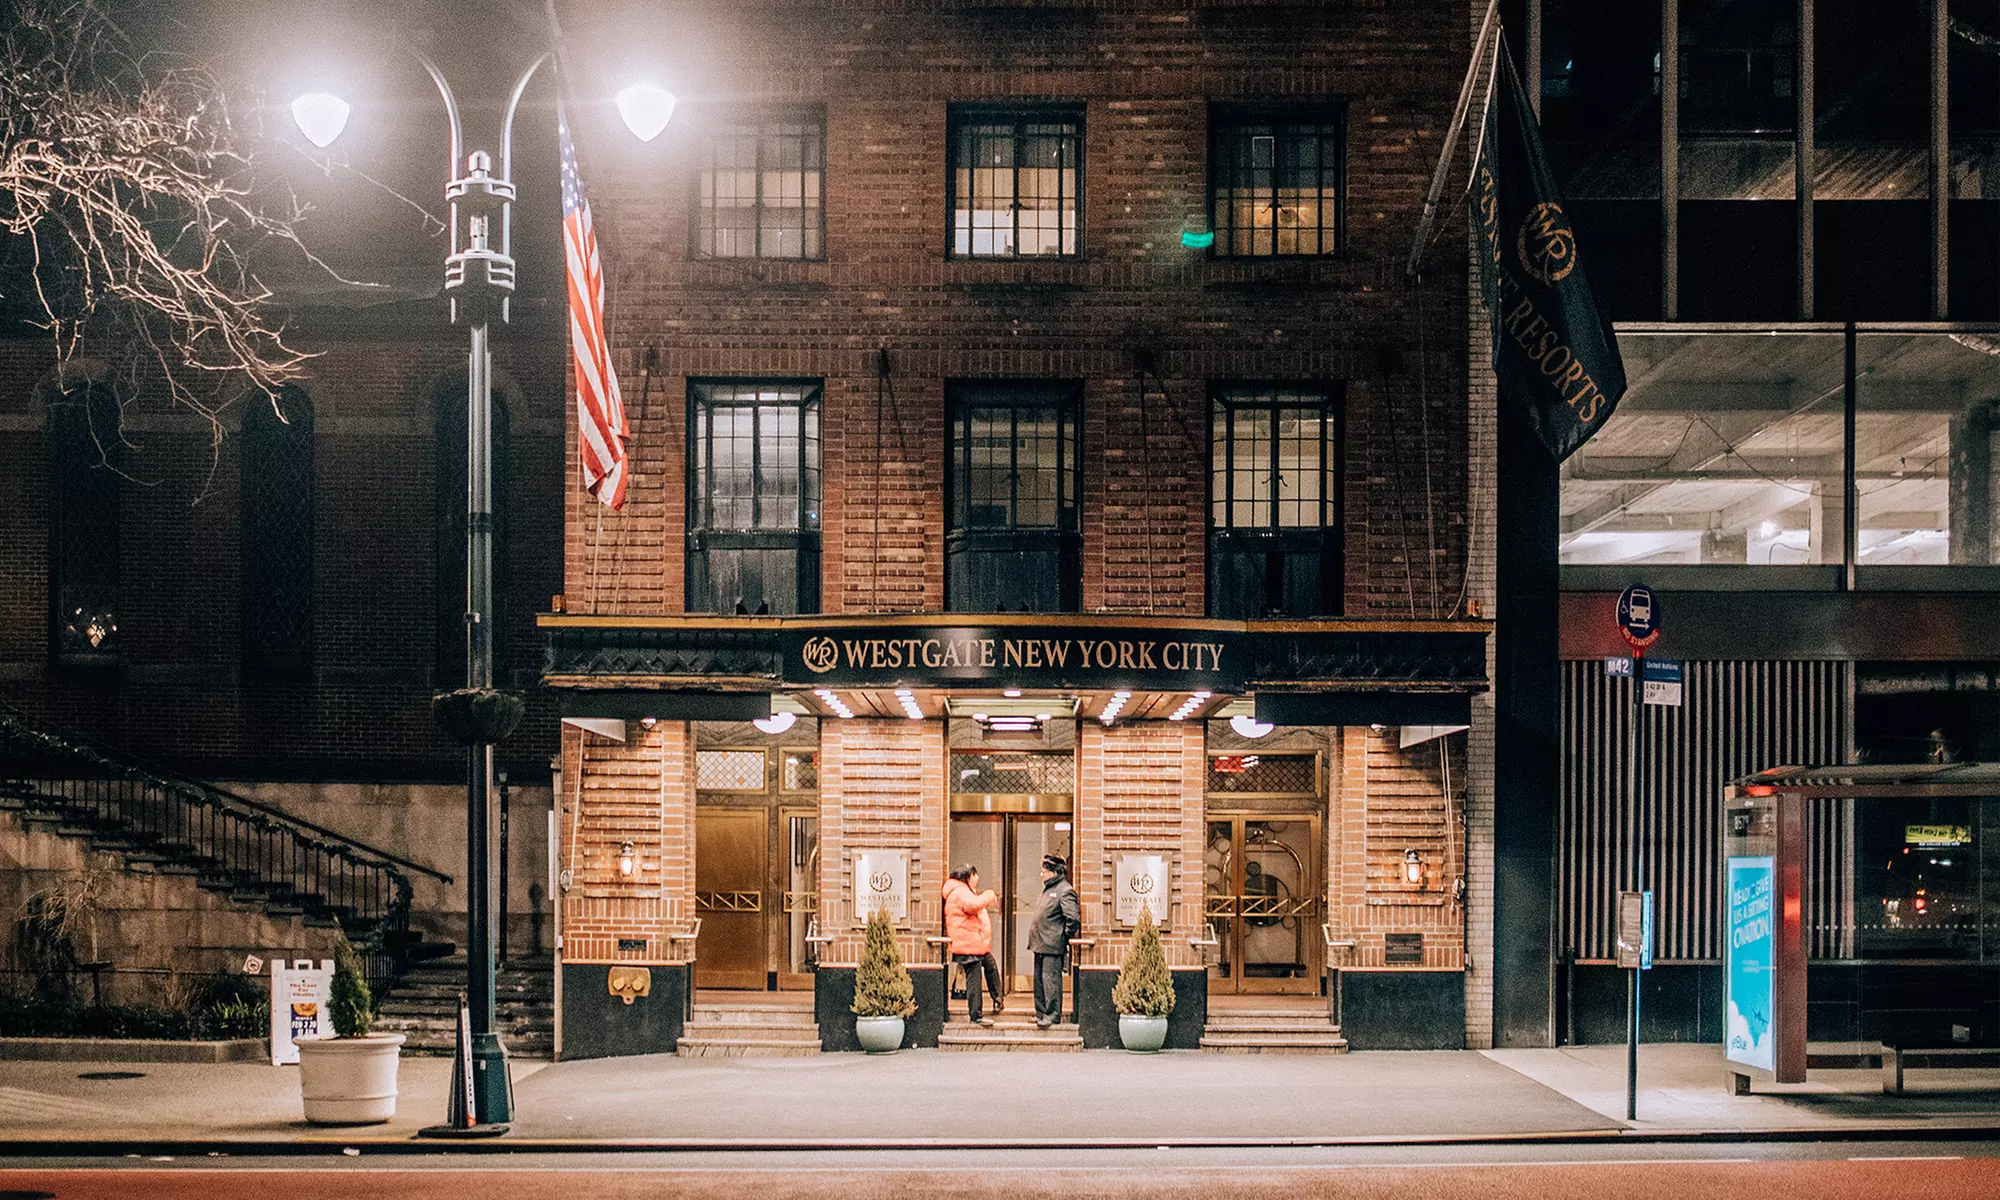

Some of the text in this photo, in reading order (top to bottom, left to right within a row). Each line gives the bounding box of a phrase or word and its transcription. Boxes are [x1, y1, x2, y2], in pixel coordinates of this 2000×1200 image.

[1504, 297, 1606, 423] RESORTS
[843, 638, 1225, 672] WESTGATE NEW YORK CITY
[1607, 659, 1629, 674] M42
[1646, 661, 1661, 669] United
